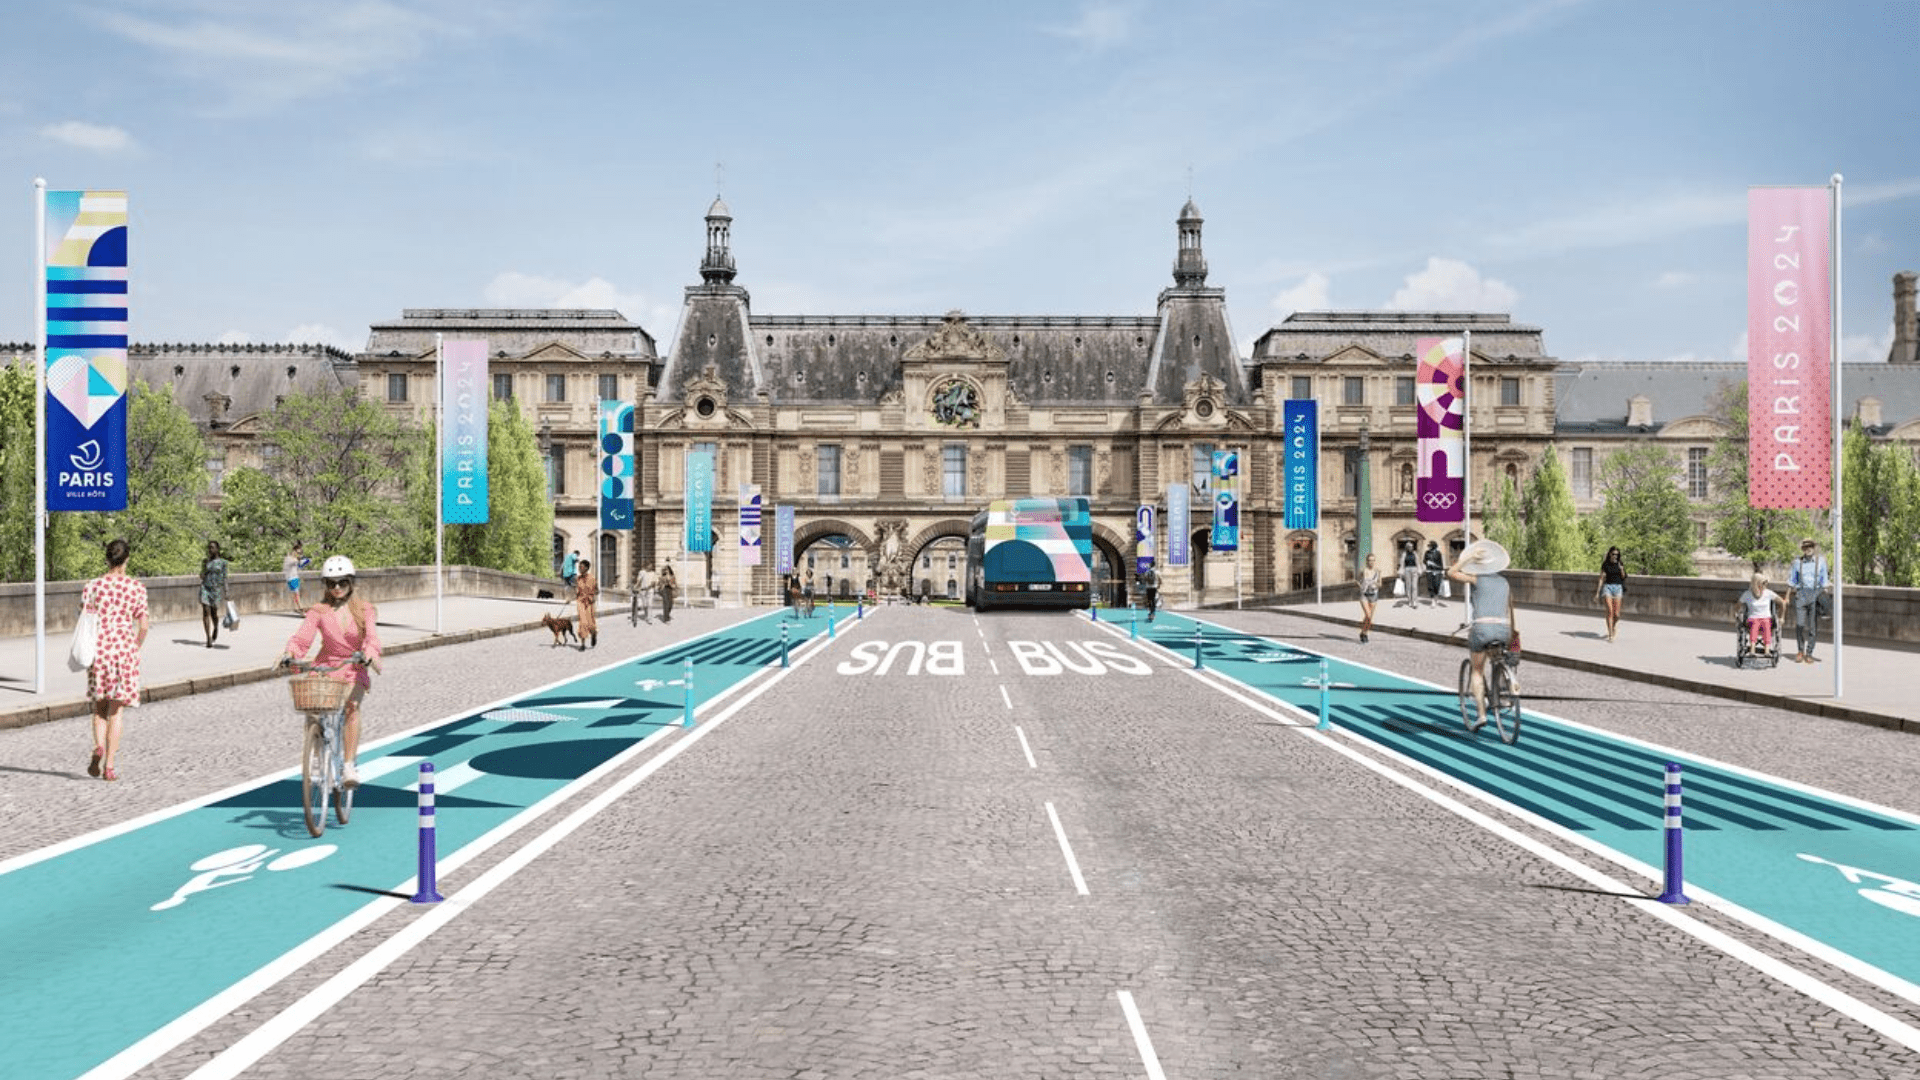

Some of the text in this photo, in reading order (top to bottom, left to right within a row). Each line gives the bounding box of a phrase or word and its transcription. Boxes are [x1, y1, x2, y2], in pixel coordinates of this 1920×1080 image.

[1774, 225, 1800, 471] PARIS 2024
[457, 361, 474, 505] PARIS 2024
[59, 471, 114, 487] PARIS
[1293, 414, 1305, 515] PARIS 2024
[694, 502, 704, 541] PARIS
[836, 640, 965, 676] BUS
[1007, 640, 1153, 676] BUS
